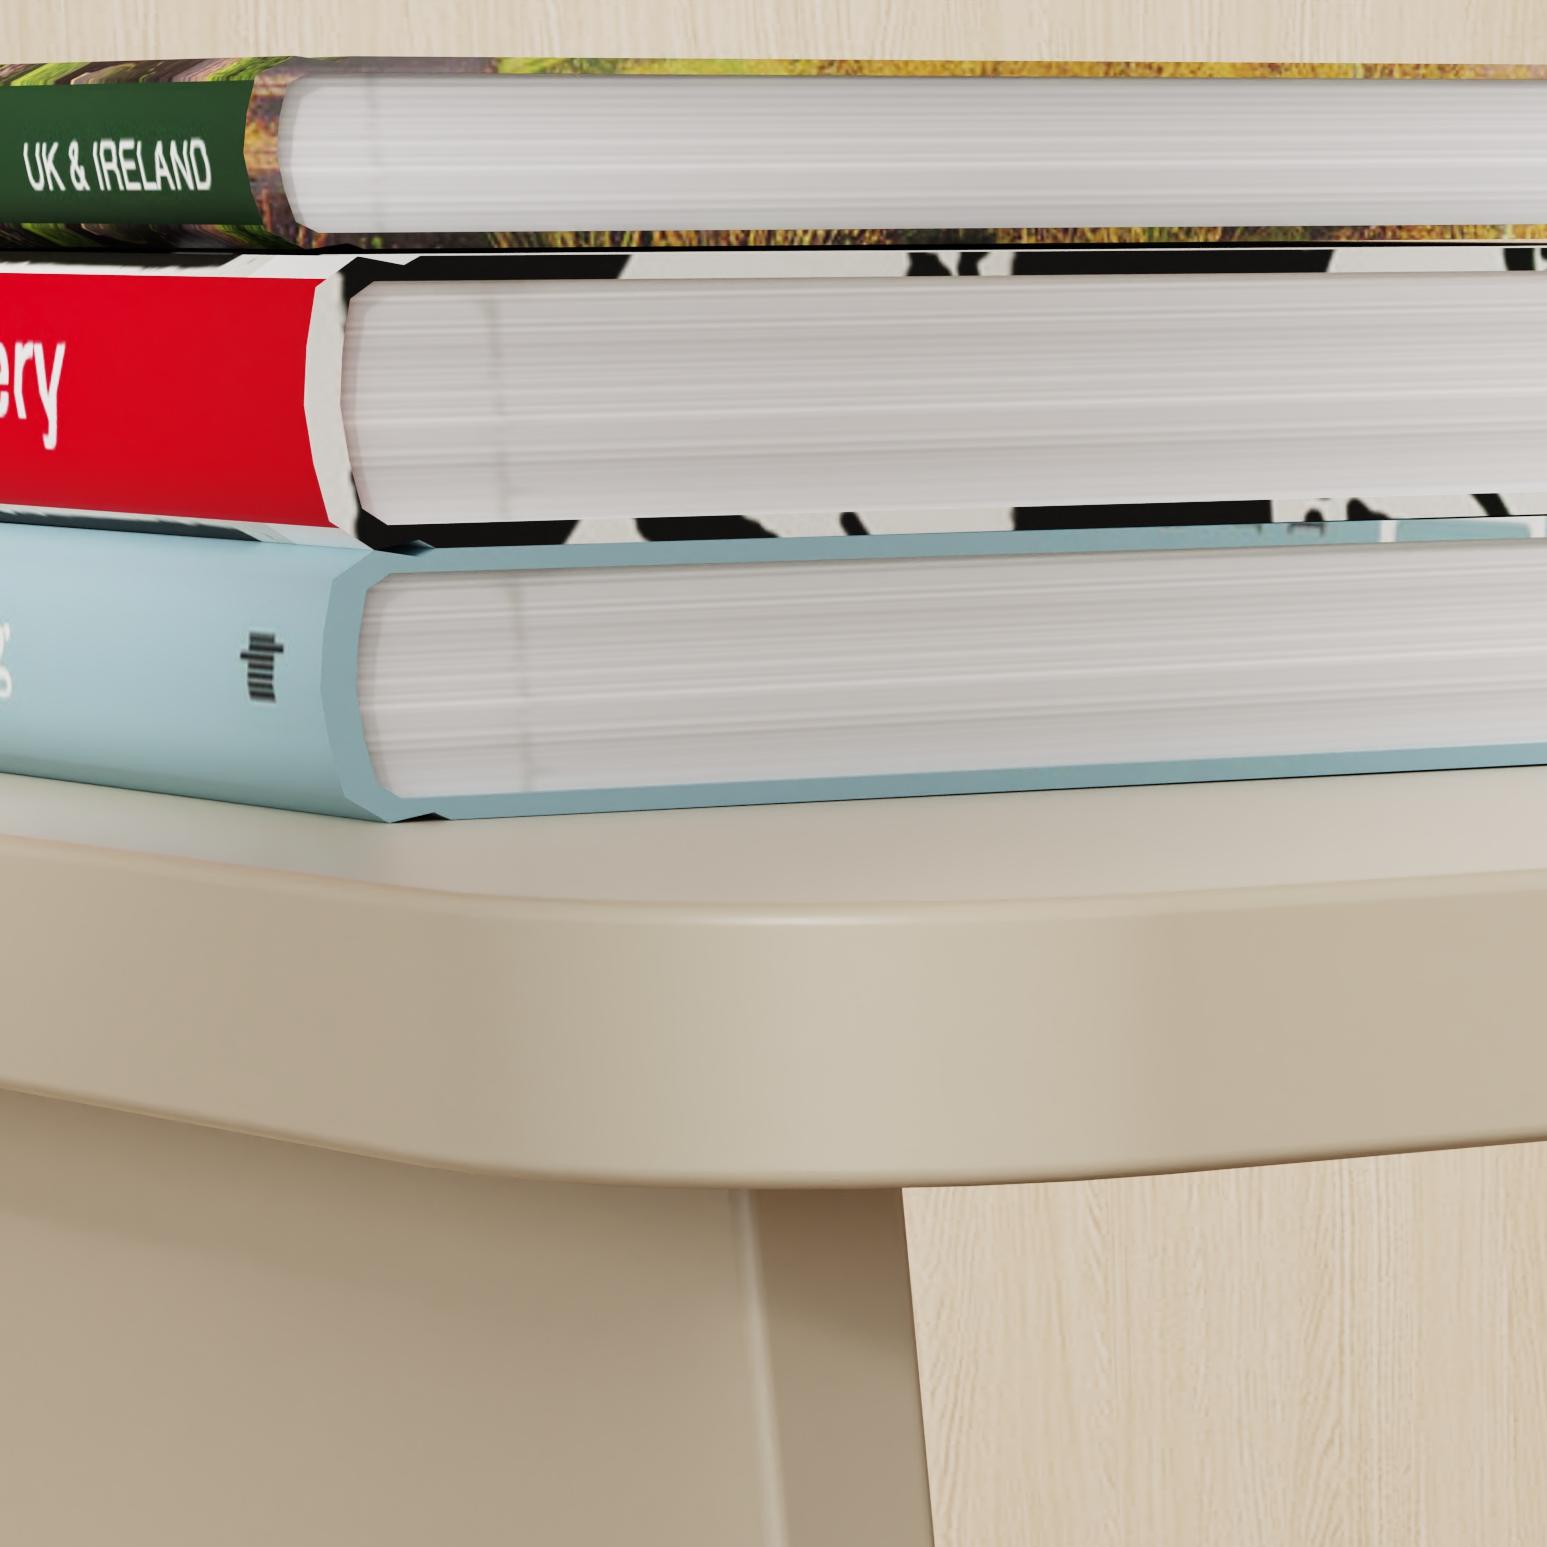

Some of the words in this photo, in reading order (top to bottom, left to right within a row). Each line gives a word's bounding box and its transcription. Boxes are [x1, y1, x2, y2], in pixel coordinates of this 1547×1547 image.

[23, 141, 65, 192] UK
[68, 141, 90, 192] &
[92, 138, 212, 192] IRELAND
